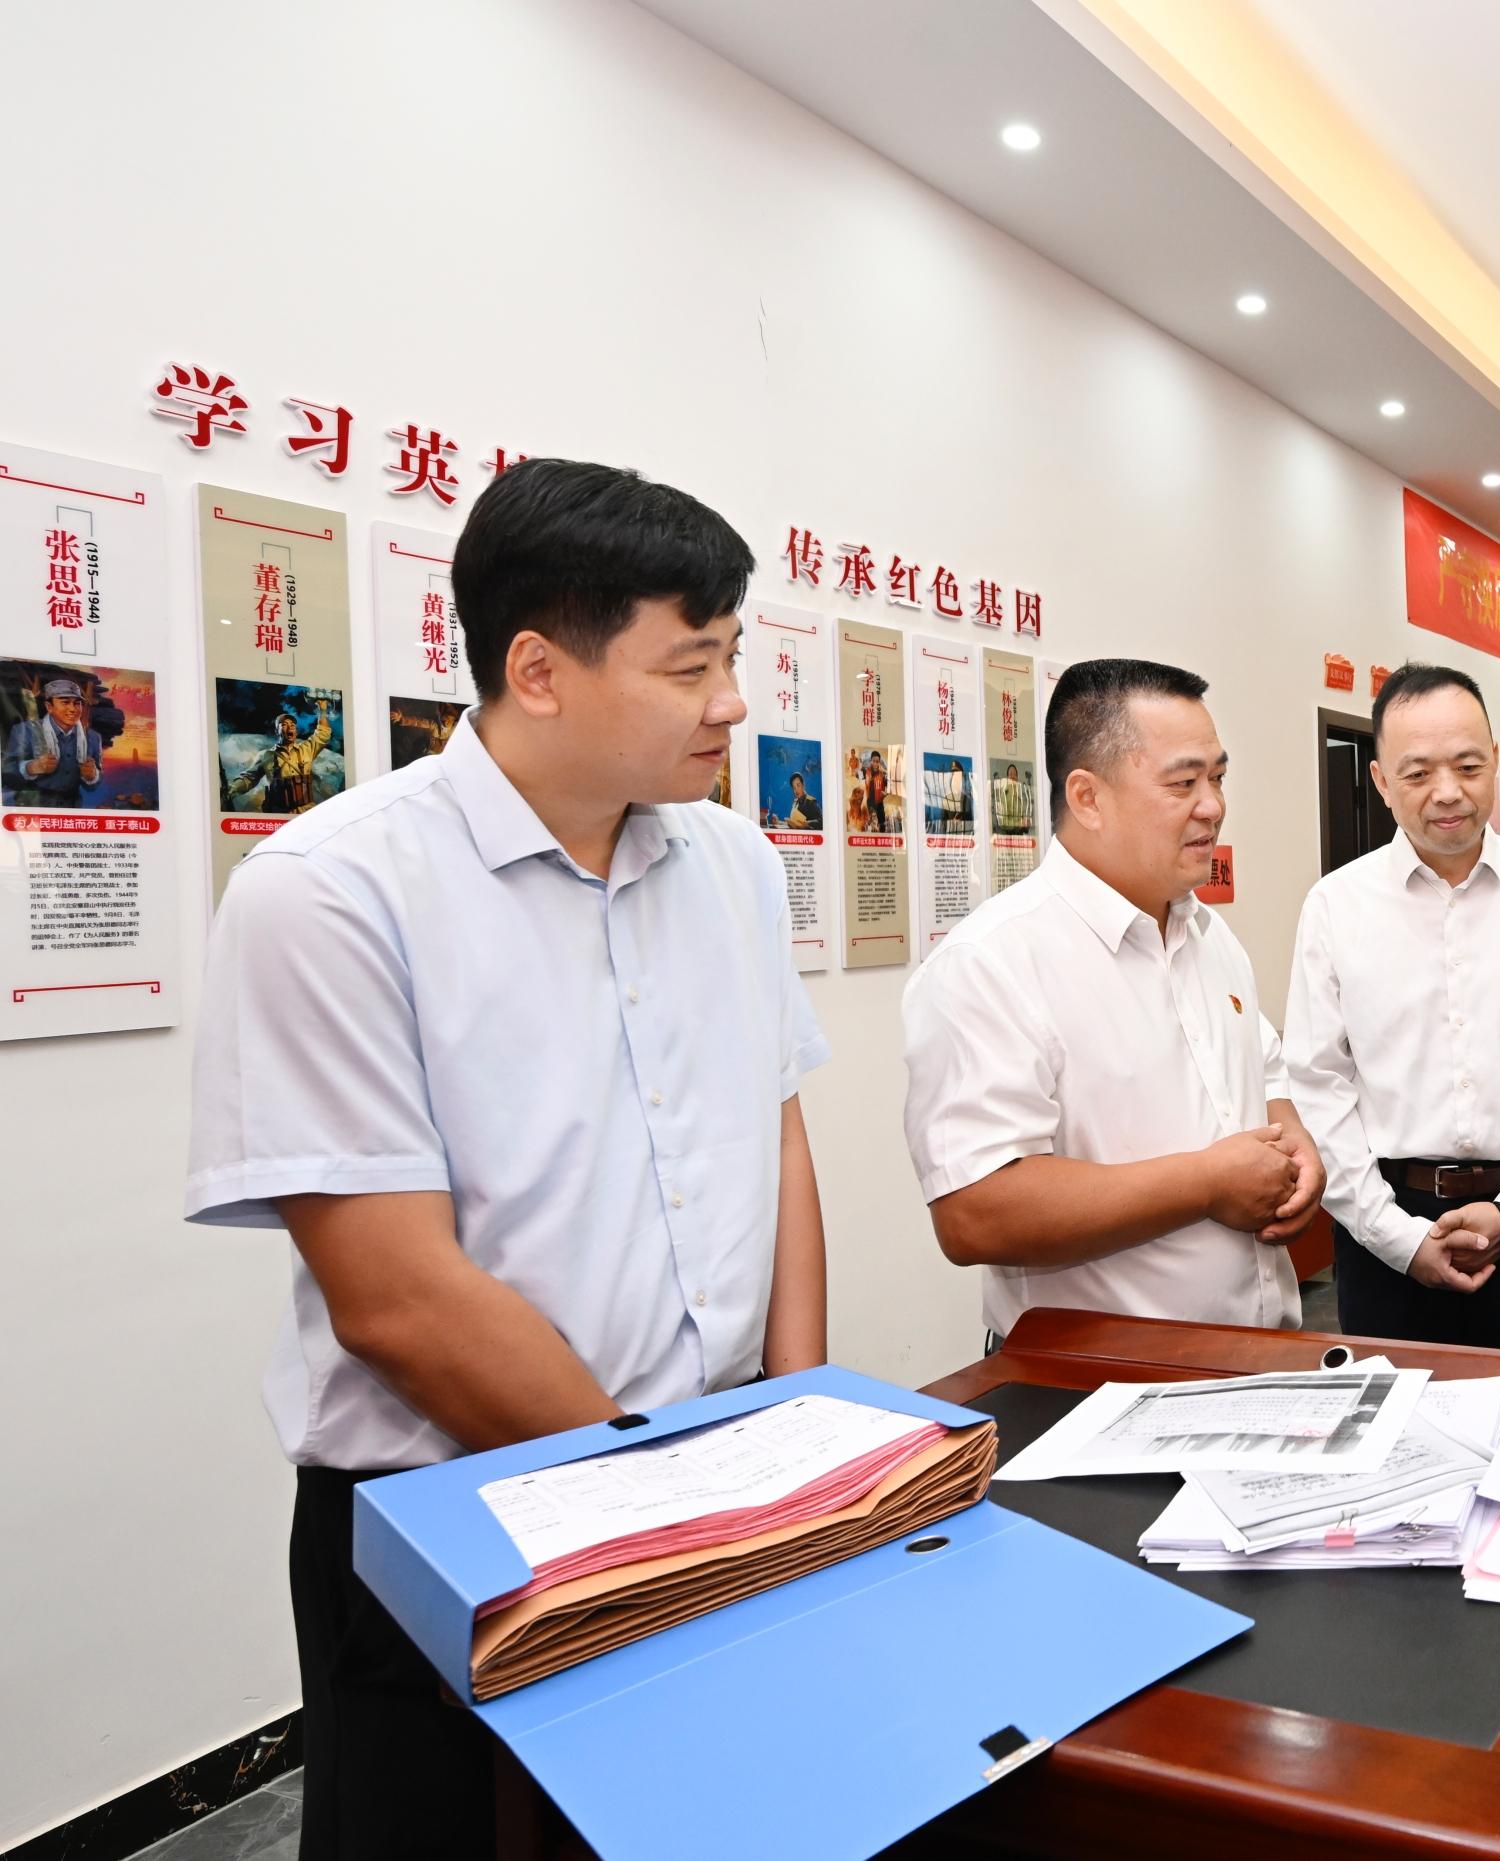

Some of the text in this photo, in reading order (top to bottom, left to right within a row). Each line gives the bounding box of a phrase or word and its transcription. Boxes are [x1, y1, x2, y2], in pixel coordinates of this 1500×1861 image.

[45, 529, 84, 630] 张思德
[250, 563, 283, 653] 董存瑞
[784, 525, 1042, 638] 传承红色基因
[421, 592, 448, 674] 黄继光
[862, 667, 875, 727] 李向群
[938, 680, 949, 736] 杨业功
[1002, 690, 1013, 742] 林俊德
[14, 816, 150, 831] 为人民利益而死 重于泰山
[230, 821, 286, 831] 完成党交给的
[1207, 858, 1231, 887] 票处
